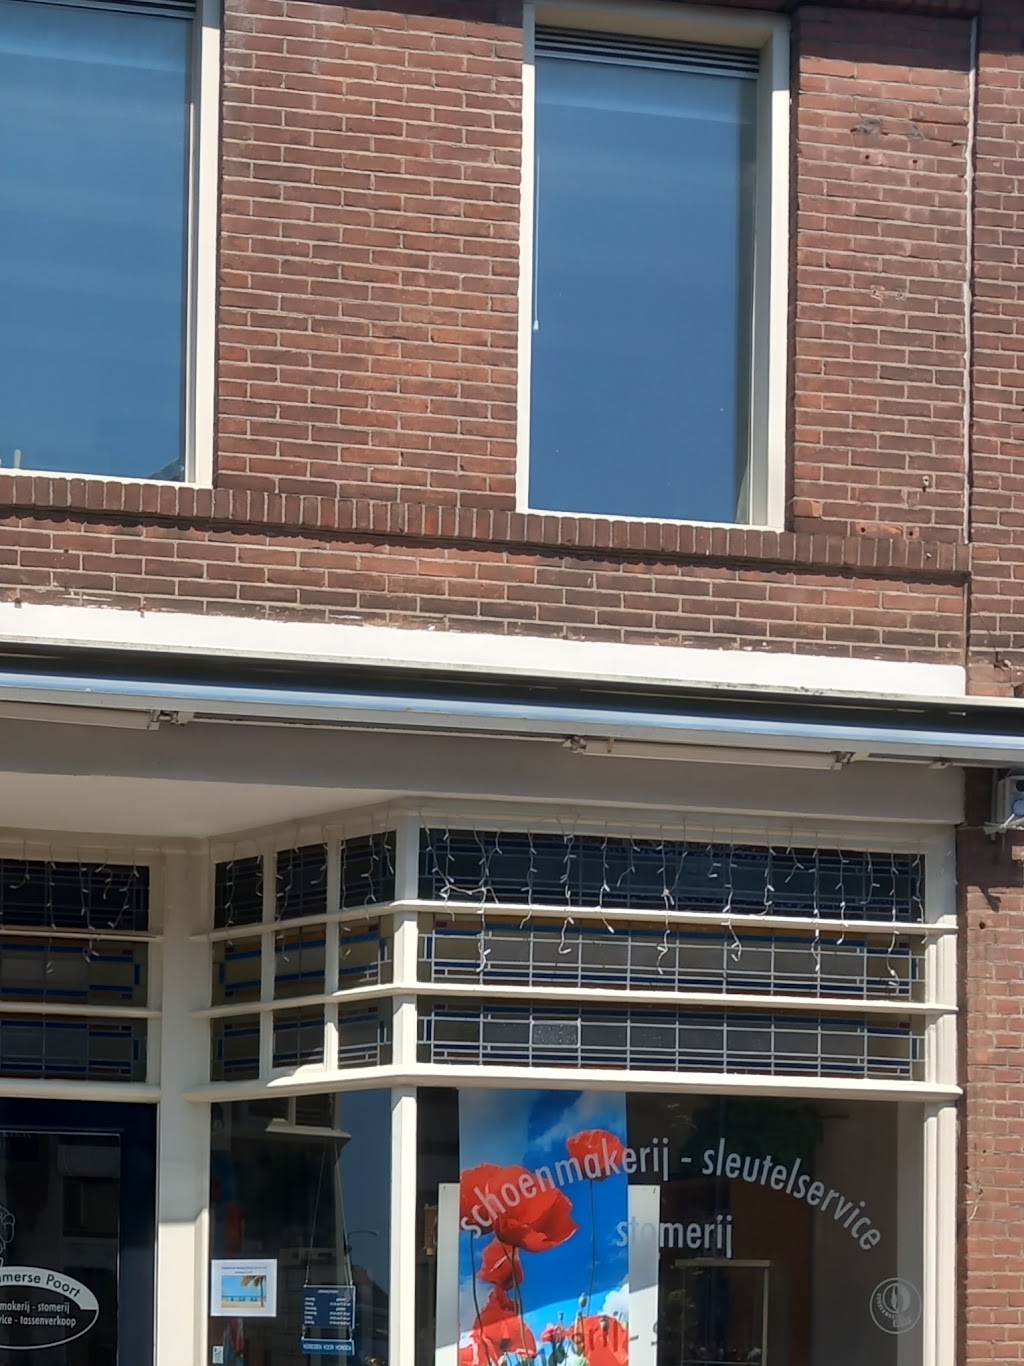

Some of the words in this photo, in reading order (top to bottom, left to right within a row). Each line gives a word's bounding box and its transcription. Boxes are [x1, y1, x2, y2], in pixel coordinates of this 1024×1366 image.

[460, 1137, 669, 1239] schoenmakerij
[701, 1137, 882, 1250] sleutelservice
[46, 1274, 82, 1298] Poort
[37, 1301, 70, 1314] stomerij
[20, 1315, 77, 1328] tassenverkoop
